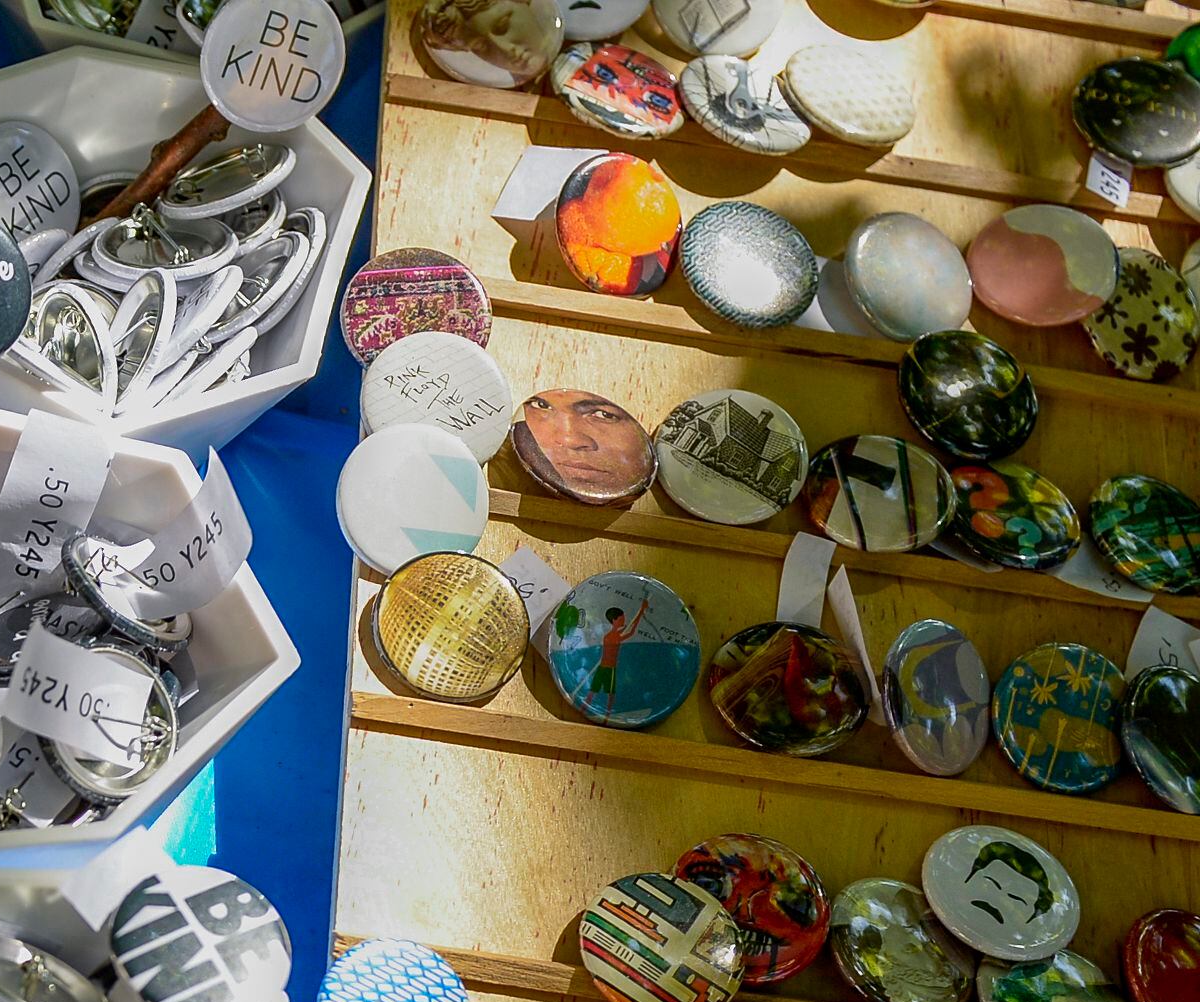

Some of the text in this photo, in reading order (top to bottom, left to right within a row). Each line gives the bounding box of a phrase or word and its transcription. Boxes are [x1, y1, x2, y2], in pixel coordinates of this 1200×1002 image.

[259, 10, 318, 58] BE
[221, 44, 322, 103] KIND
[1, 171, 71, 243] KIND
[384, 365, 431, 388] PINK
[400, 373, 450, 403] FLOYD
[435, 398, 506, 431] WALL
[38, 466, 70, 509] .50
[14, 519, 58, 580] Y245
[179, 511, 223, 569] Y245
[19, 666, 69, 713] Y245
[185, 880, 290, 984] BE
